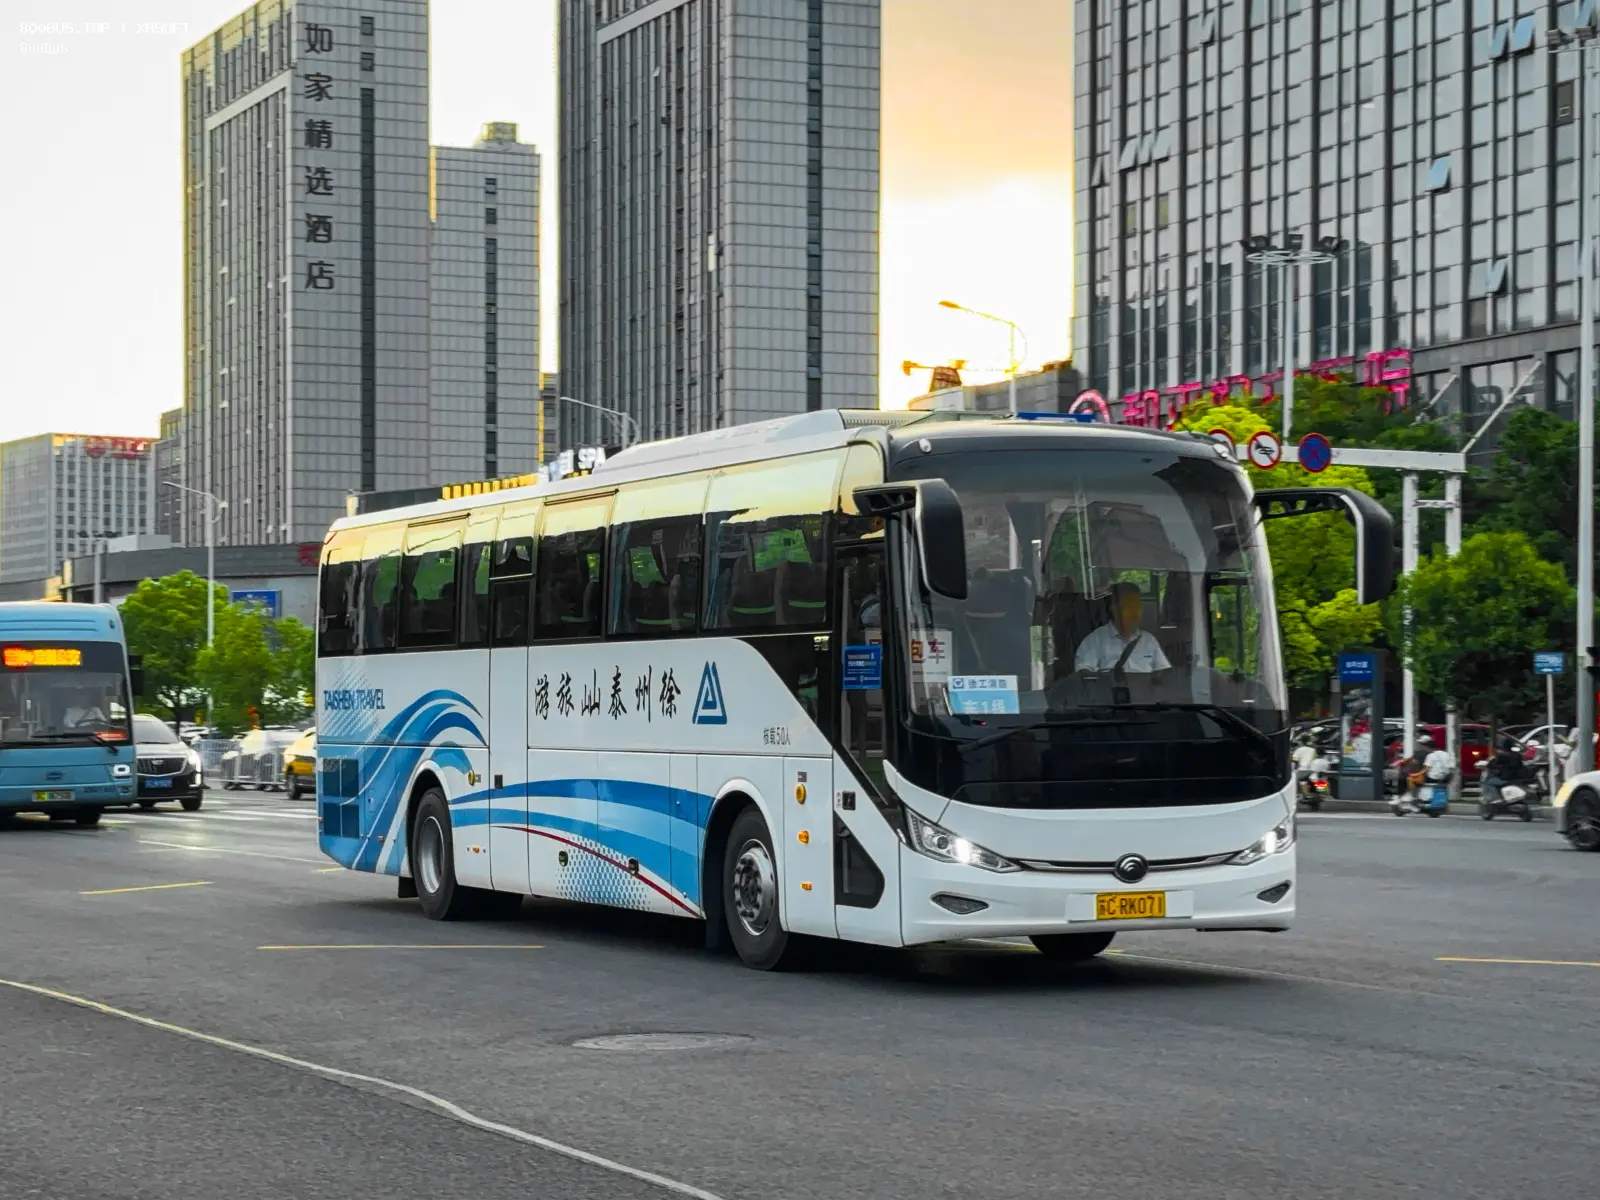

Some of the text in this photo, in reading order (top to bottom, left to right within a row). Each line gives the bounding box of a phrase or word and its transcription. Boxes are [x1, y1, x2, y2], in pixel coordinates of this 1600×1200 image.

[304, 23, 335, 291] 如家精选酒店
[356, 688, 386, 710] TRAVEL
